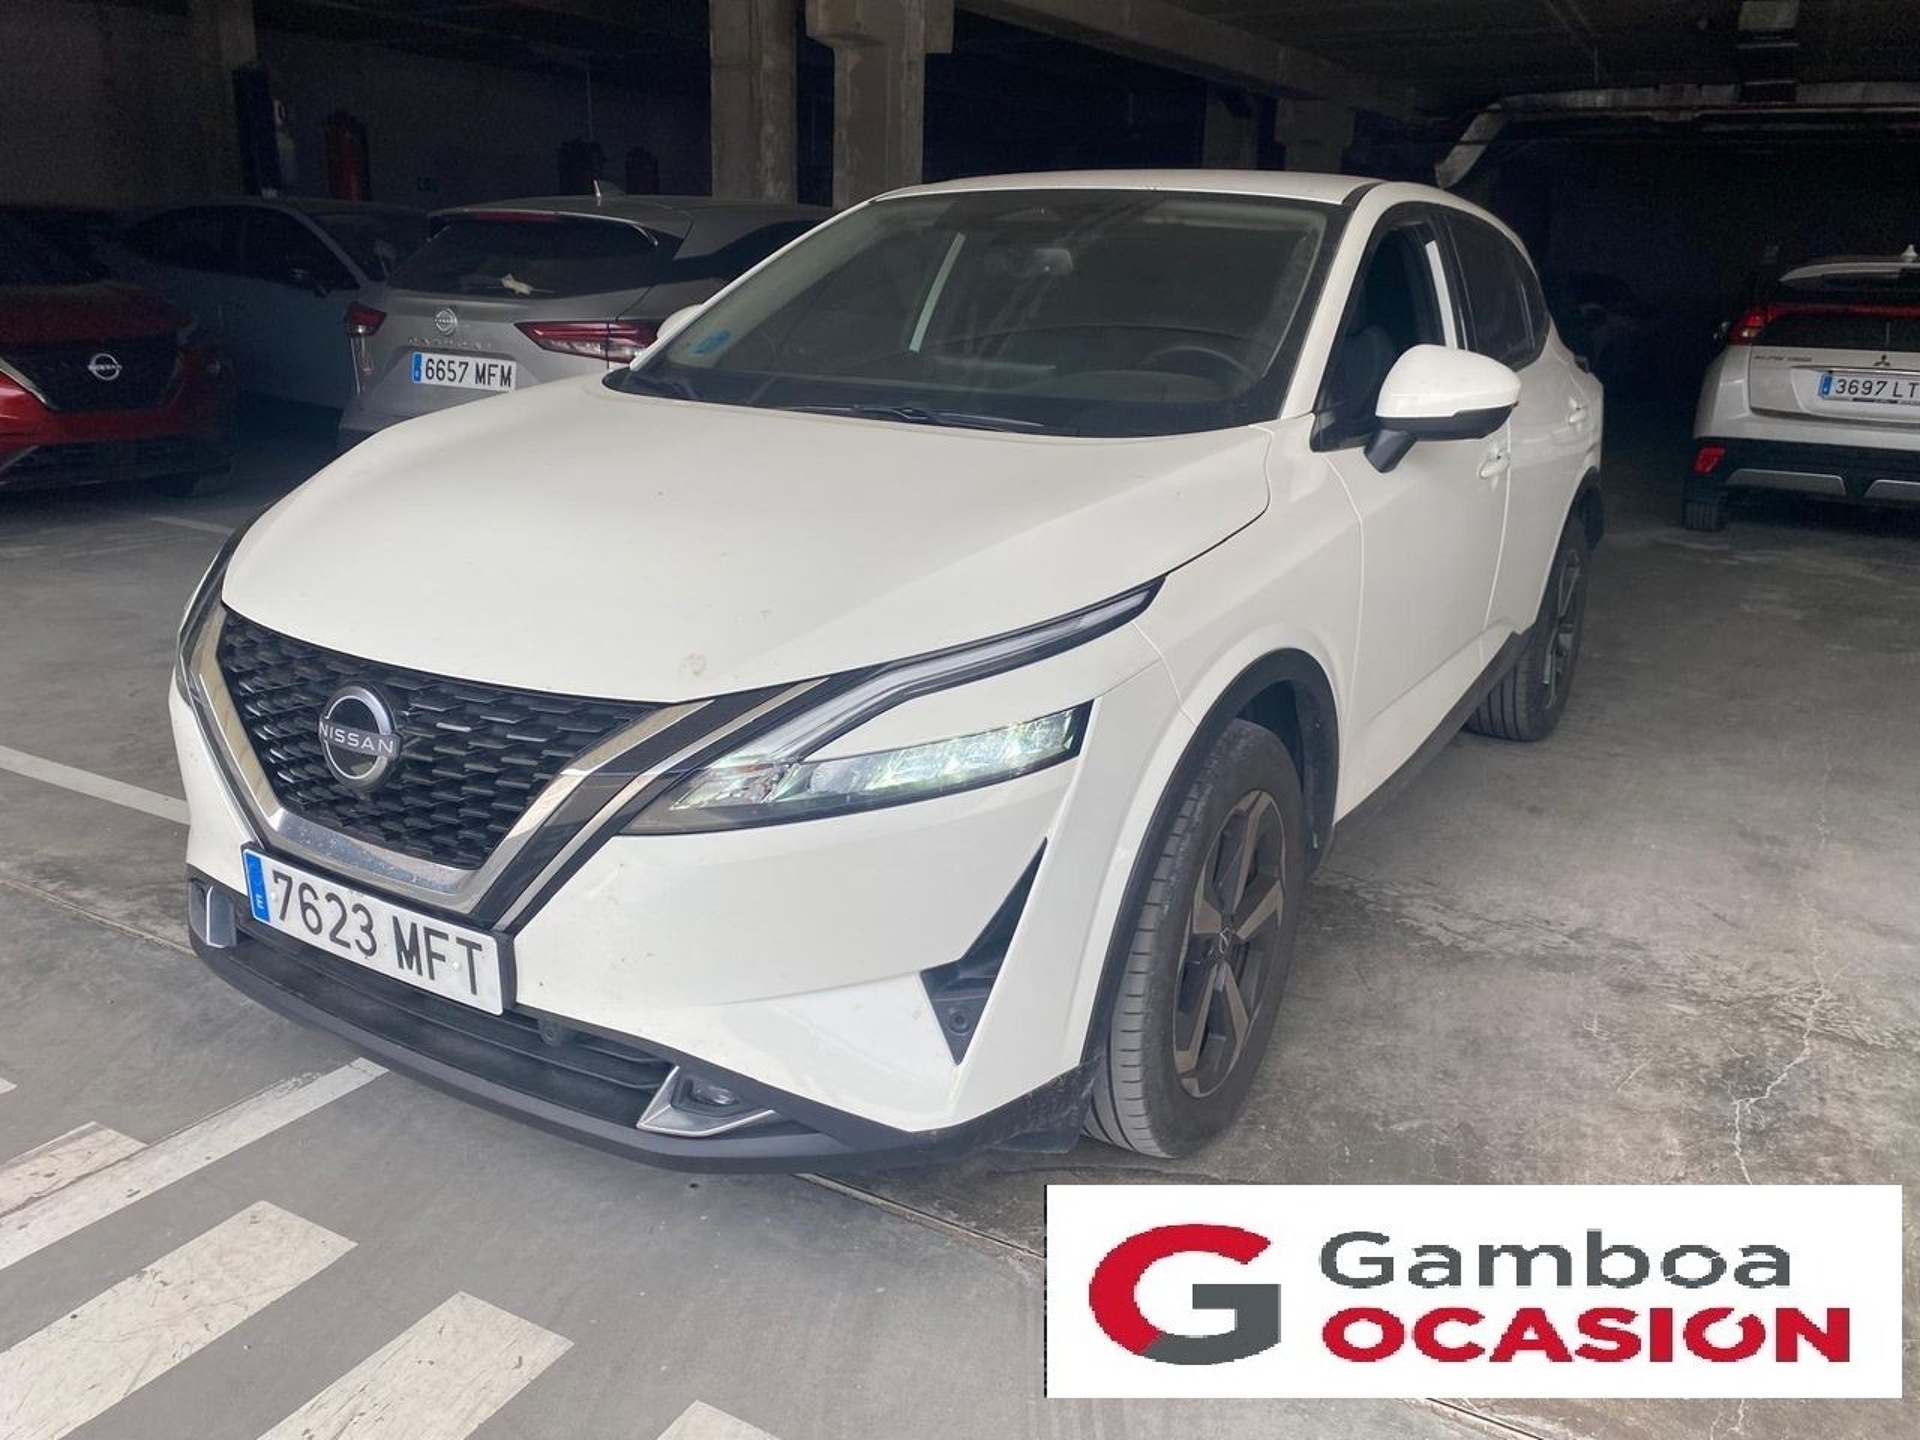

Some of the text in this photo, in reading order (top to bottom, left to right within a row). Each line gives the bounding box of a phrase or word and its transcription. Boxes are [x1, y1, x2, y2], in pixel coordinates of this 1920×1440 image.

[425, 358, 512, 388] 6657 MFM
[1835, 378, 1888, 396] 3697
[319, 720, 394, 754] NISSAN
[255, 893, 265, 910] E
[272, 869, 483, 997] 7623 MFT
